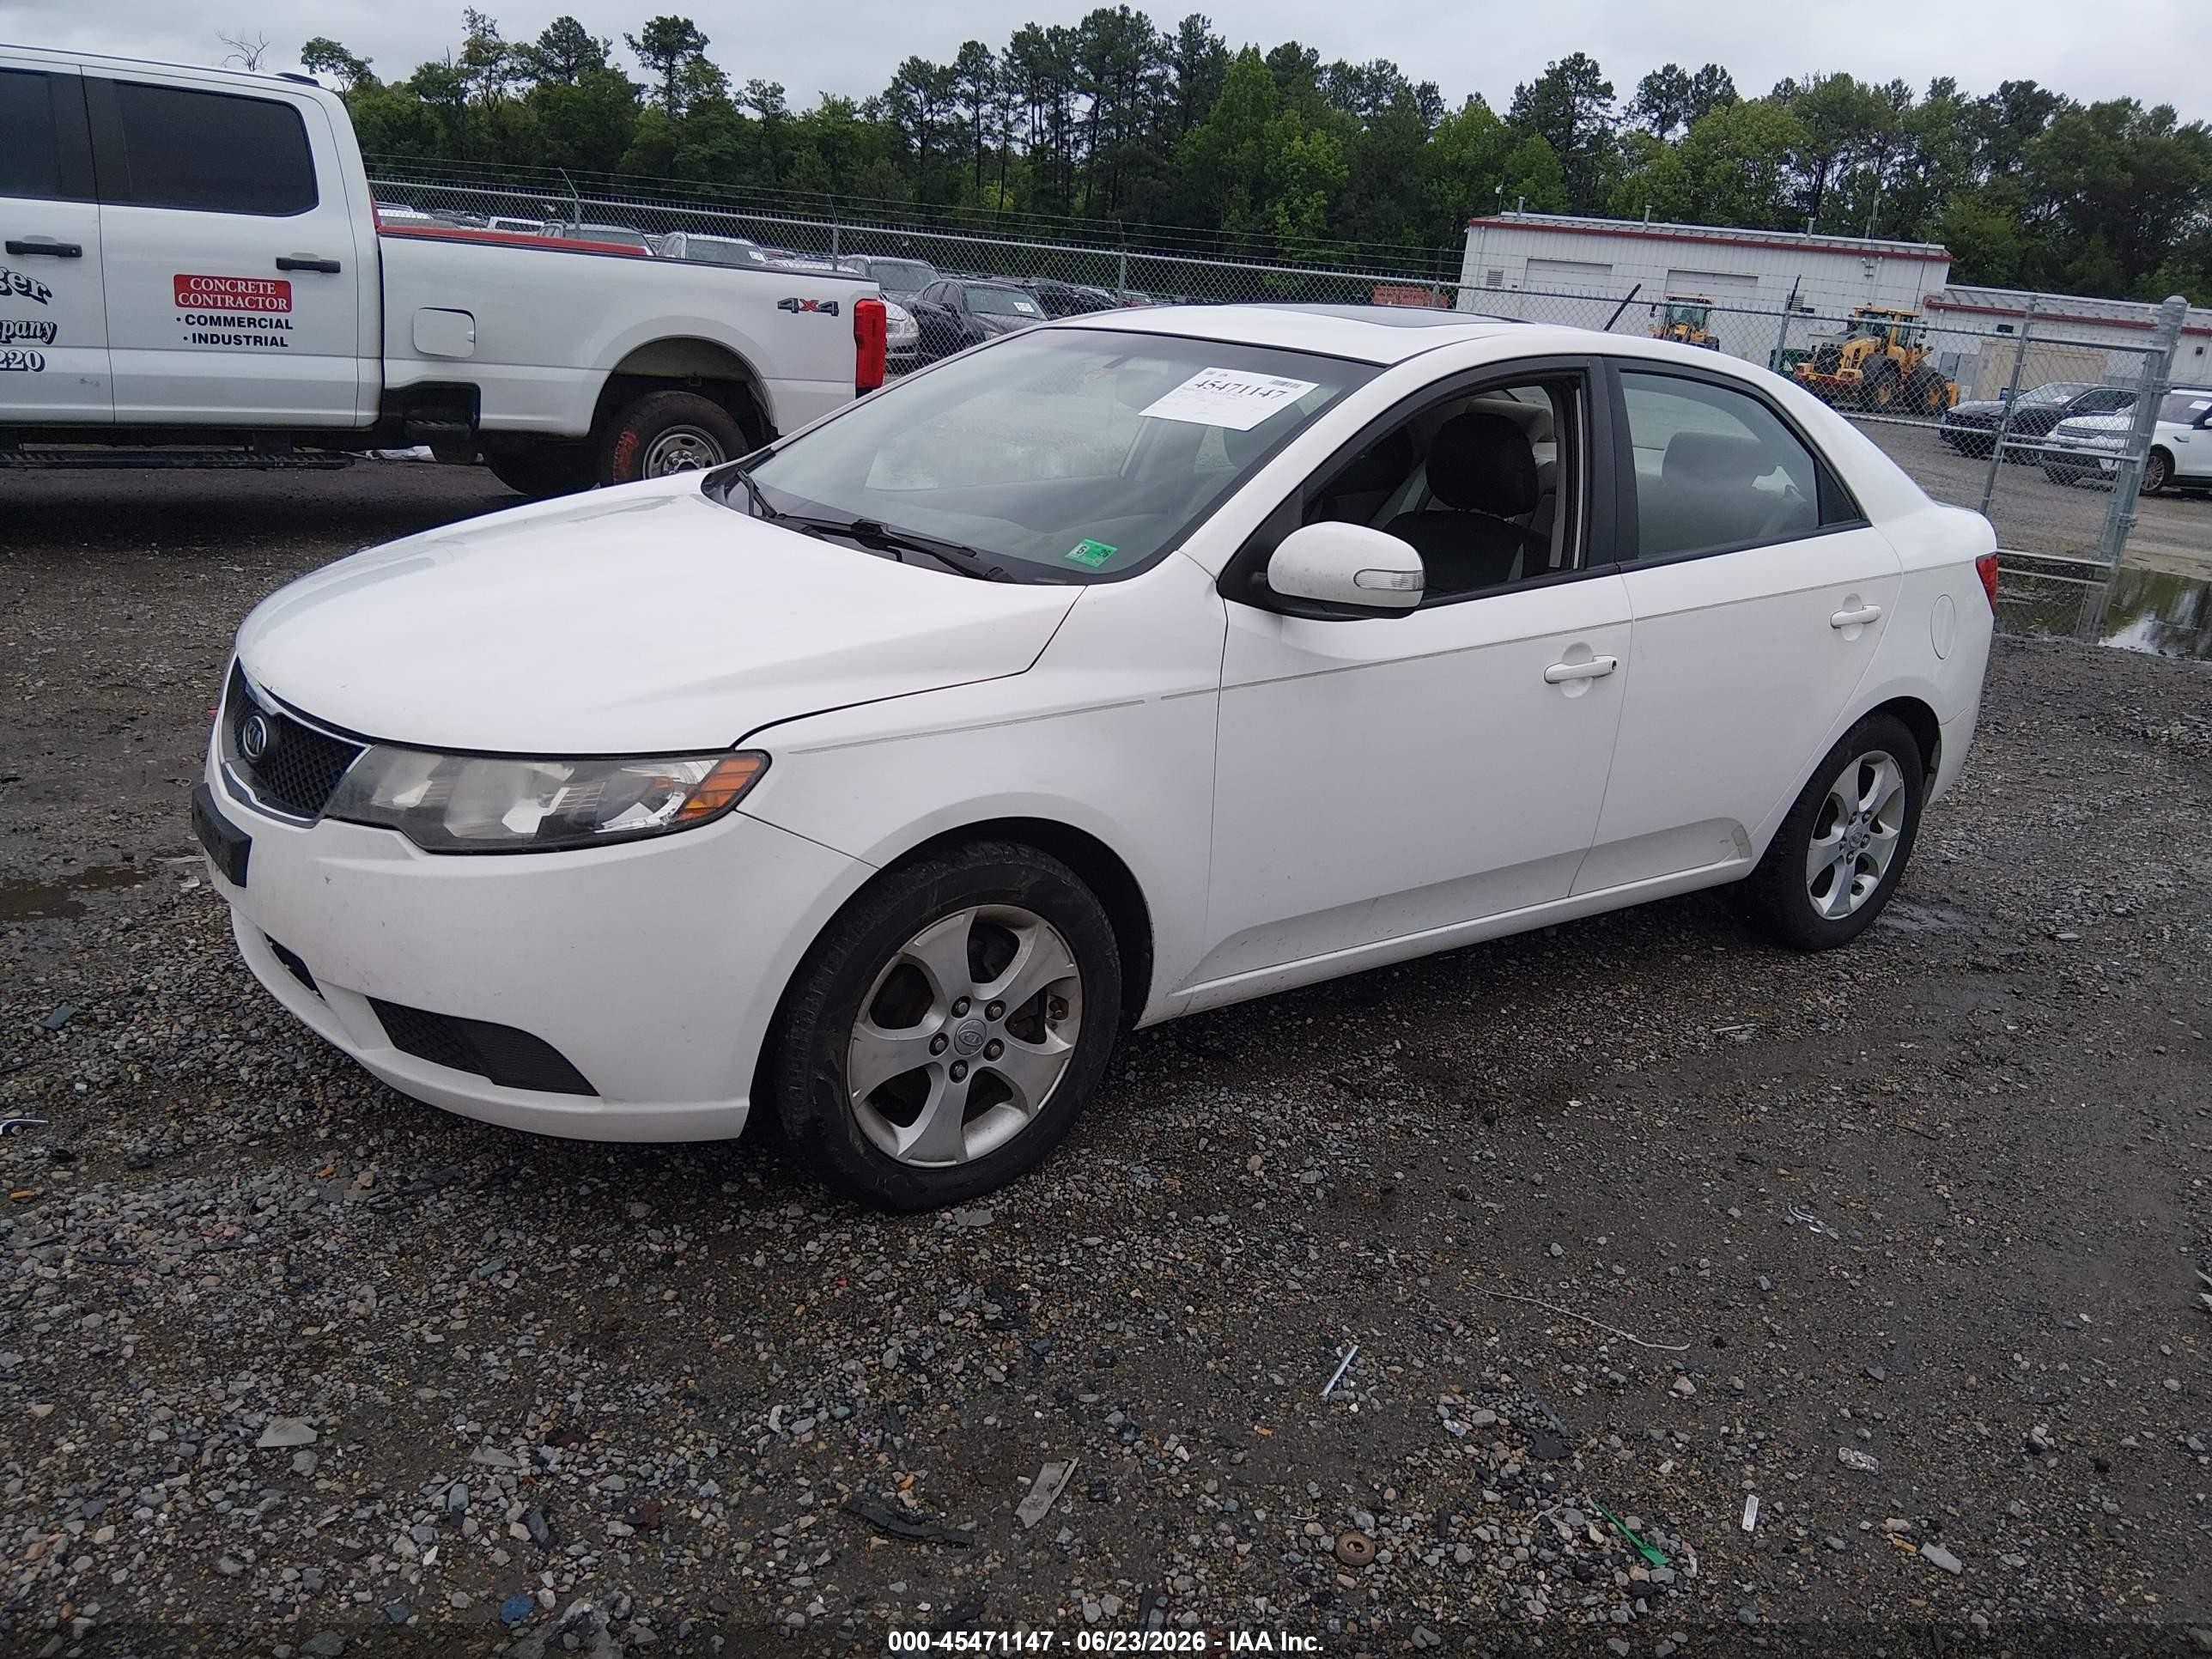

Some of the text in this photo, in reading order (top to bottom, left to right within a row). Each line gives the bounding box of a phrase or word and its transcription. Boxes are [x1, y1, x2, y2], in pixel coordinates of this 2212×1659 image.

[190, 277, 276, 295] CONCRETE
[178, 293, 289, 310] CONTRACTOR
[185, 314, 293, 330] COMMERCIAL
[191, 333, 289, 347] INDUSTRIAL
[1194, 380, 1288, 399] 45471147
